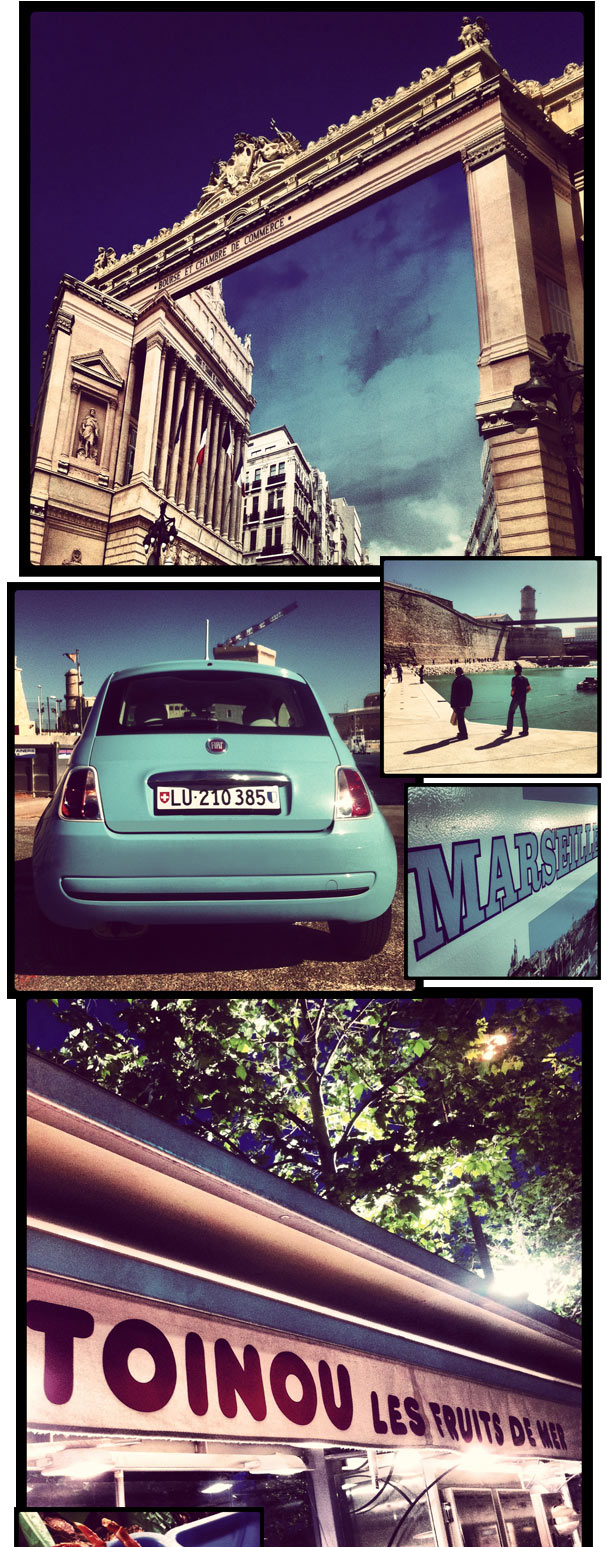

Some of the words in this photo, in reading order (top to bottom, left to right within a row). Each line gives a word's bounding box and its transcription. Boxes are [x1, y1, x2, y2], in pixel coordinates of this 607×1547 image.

[158, 271, 181, 290] BOURSE
[184, 264, 194, 276] ET
[195, 247, 227, 270] CHAMBRE
[231, 241, 240, 253] DE
[244, 217, 284, 245] COMMERCE
[210, 741, 224, 750] FIAT
[27, 1299, 354, 1431] TOINOU
[370, 1390, 426, 1437] LES
[428, 1401, 505, 1447] FRUITS
[509, 1415, 537, 1447] DE
[536, 1419, 568, 1451] MER
